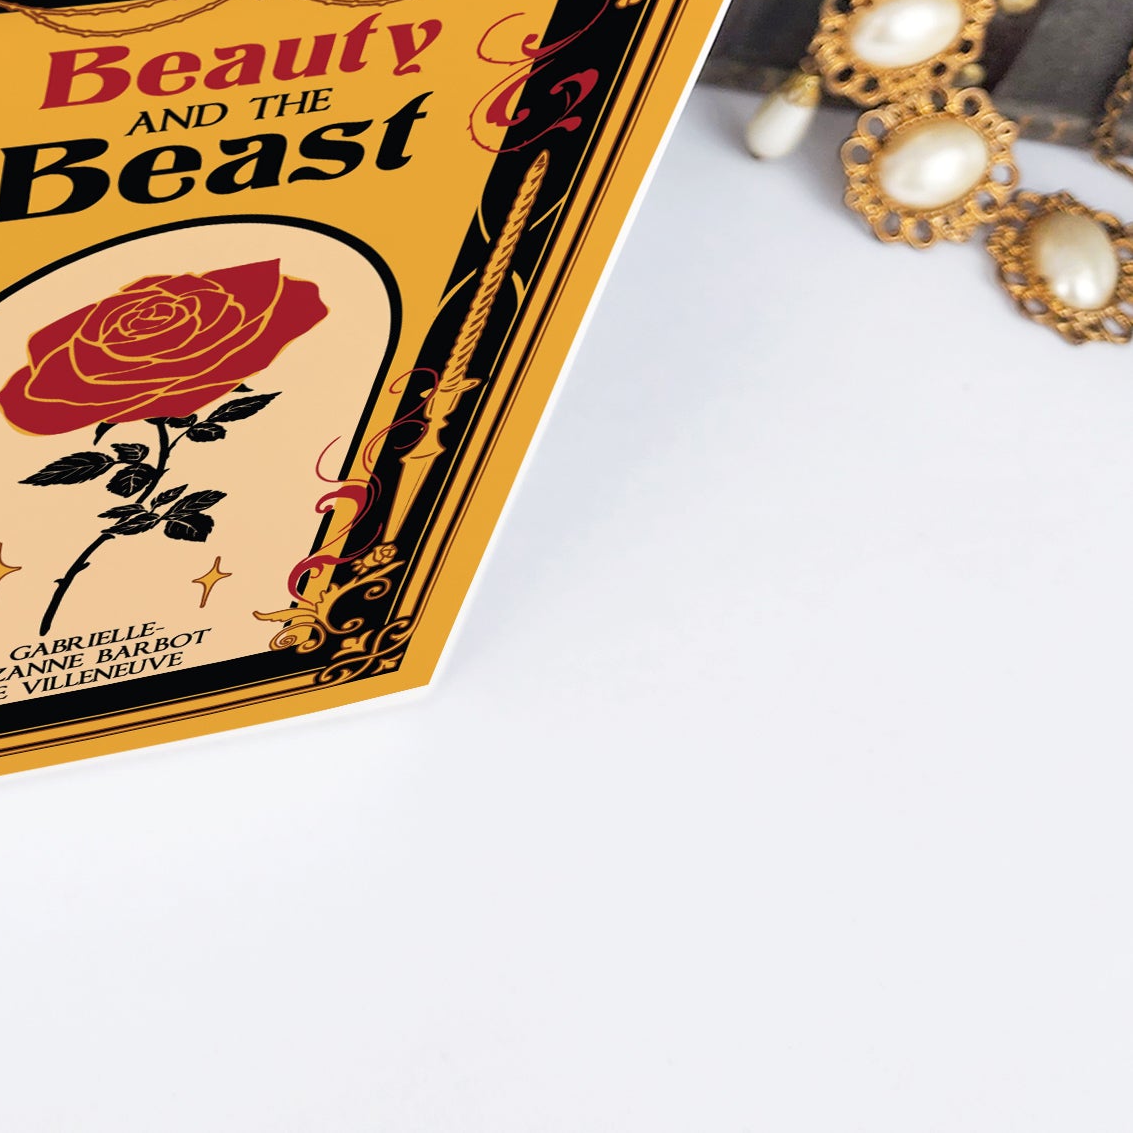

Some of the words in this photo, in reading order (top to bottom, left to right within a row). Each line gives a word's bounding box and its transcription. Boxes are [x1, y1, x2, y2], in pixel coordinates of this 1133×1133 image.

[38, 12, 443, 110] Beauty
[125, 102, 228, 136] AND
[250, 88, 333, 120] THE
[9, 621, 166, 661] GABRIELLE-
[96, 628, 213, 664] BARBOT
[22, 651, 184, 695] VILLENEUVE
